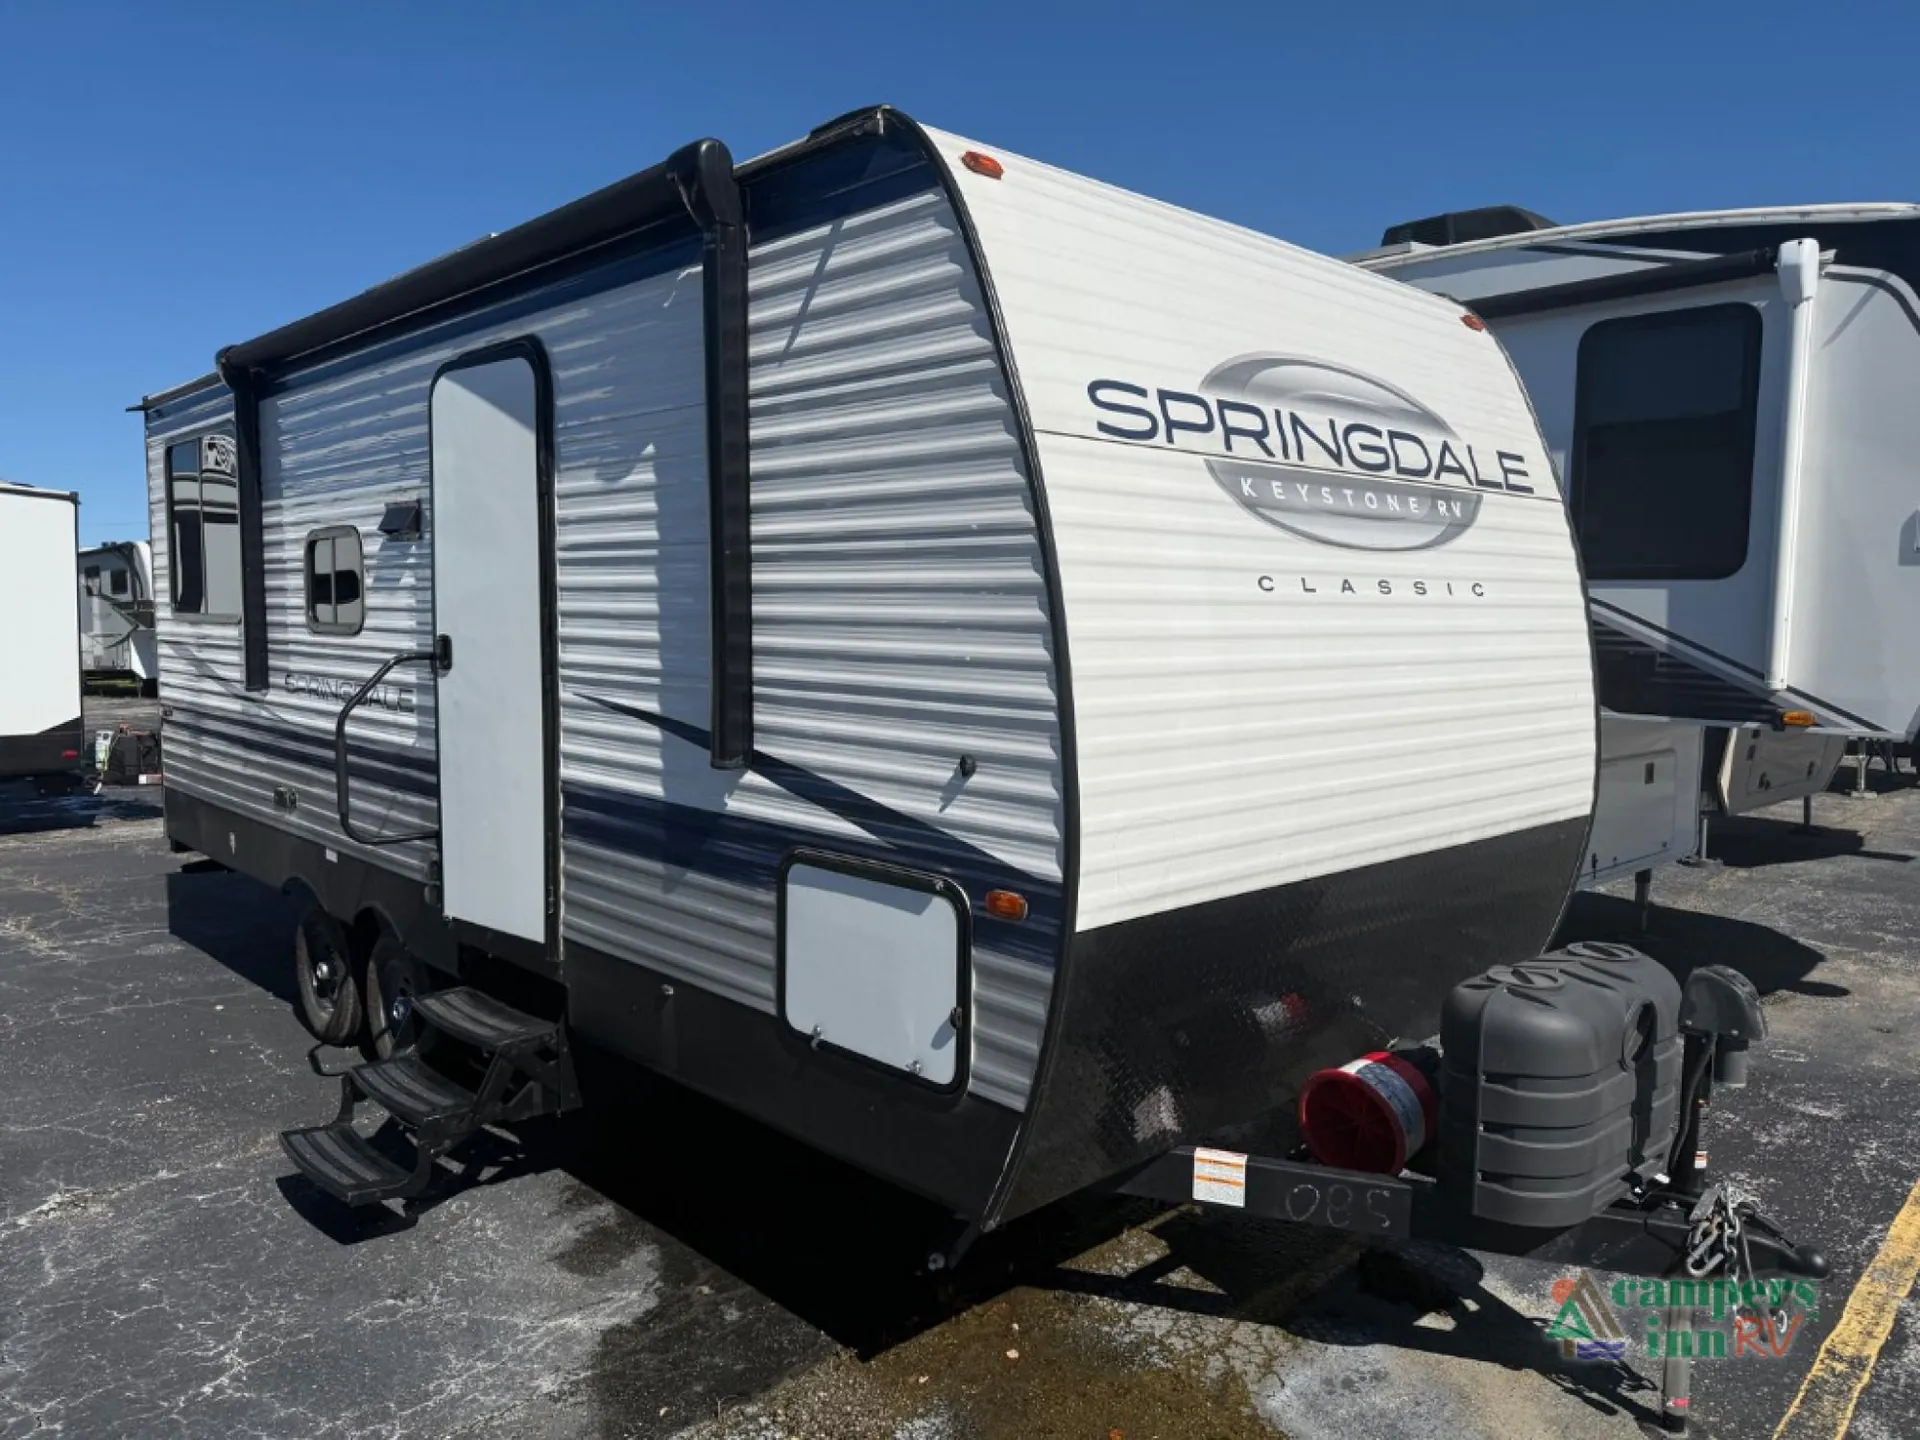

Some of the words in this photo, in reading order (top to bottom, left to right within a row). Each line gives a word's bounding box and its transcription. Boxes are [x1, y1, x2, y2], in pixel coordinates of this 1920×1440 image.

[1087, 378, 1535, 494] SPRINGDALE
[1240, 476, 1420, 515] KEYSTONE
[1438, 498, 1463, 519] RV
[1257, 575, 1485, 598] CLASSIC
[285, 672, 416, 713] SPRINGALE
